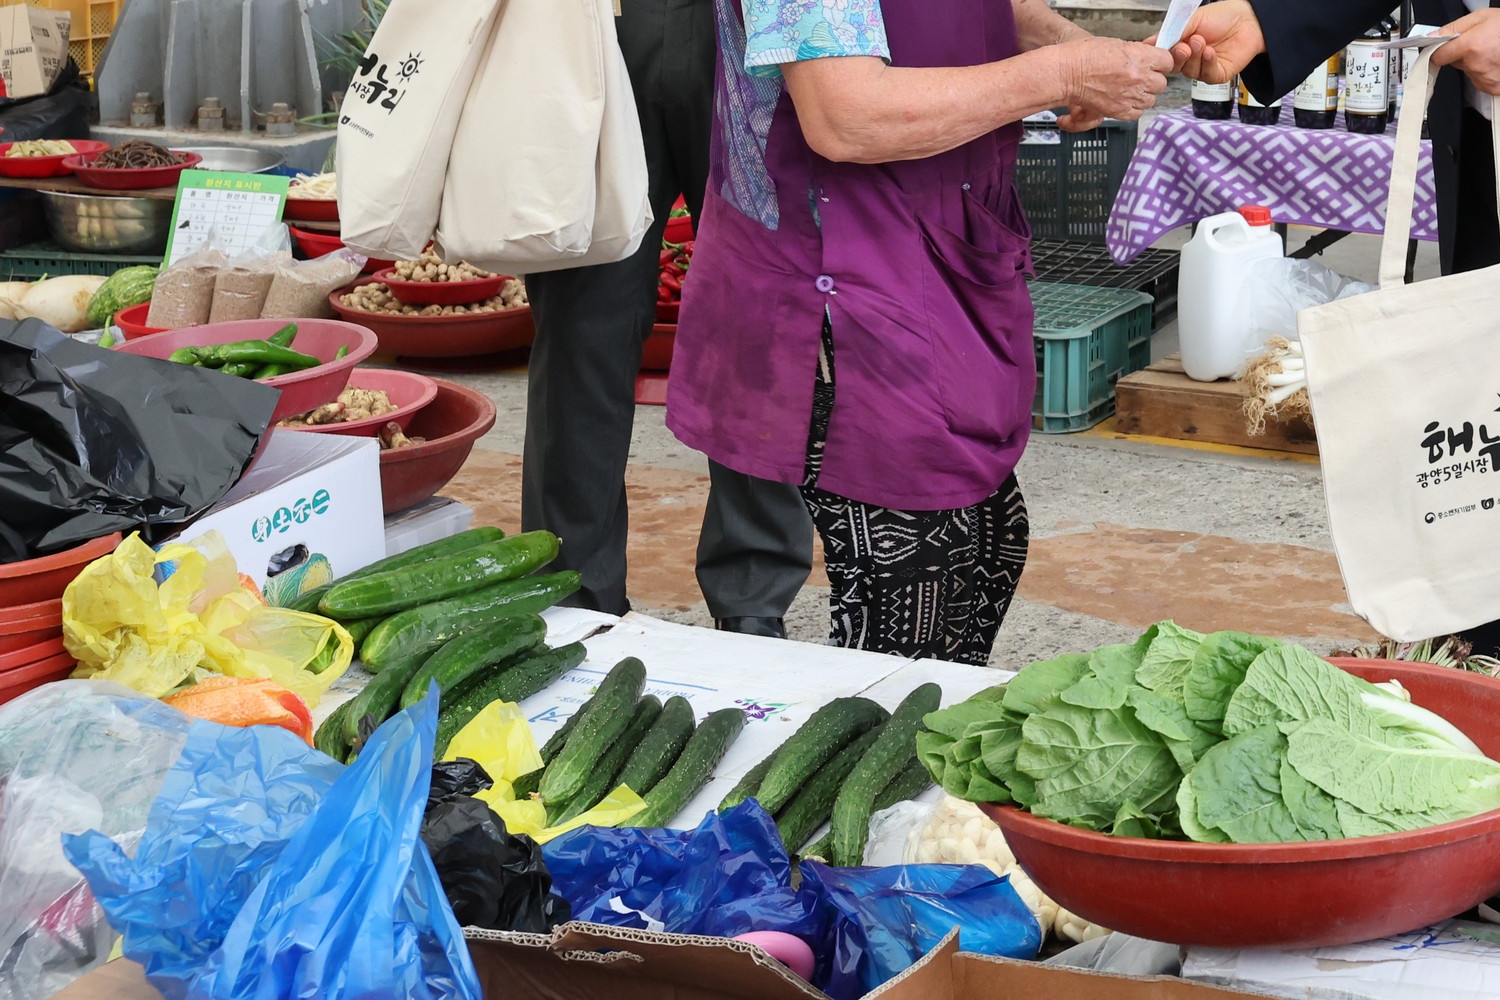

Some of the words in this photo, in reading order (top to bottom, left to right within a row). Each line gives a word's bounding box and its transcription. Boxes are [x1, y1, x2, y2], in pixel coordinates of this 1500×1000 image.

[205, 178, 232, 188] 원산지
[235, 180, 262, 190] 표시판
[1416, 458, 1489, 488] 광양5일시장
[1437, 504, 1477, 519] 중소벤처기업부
